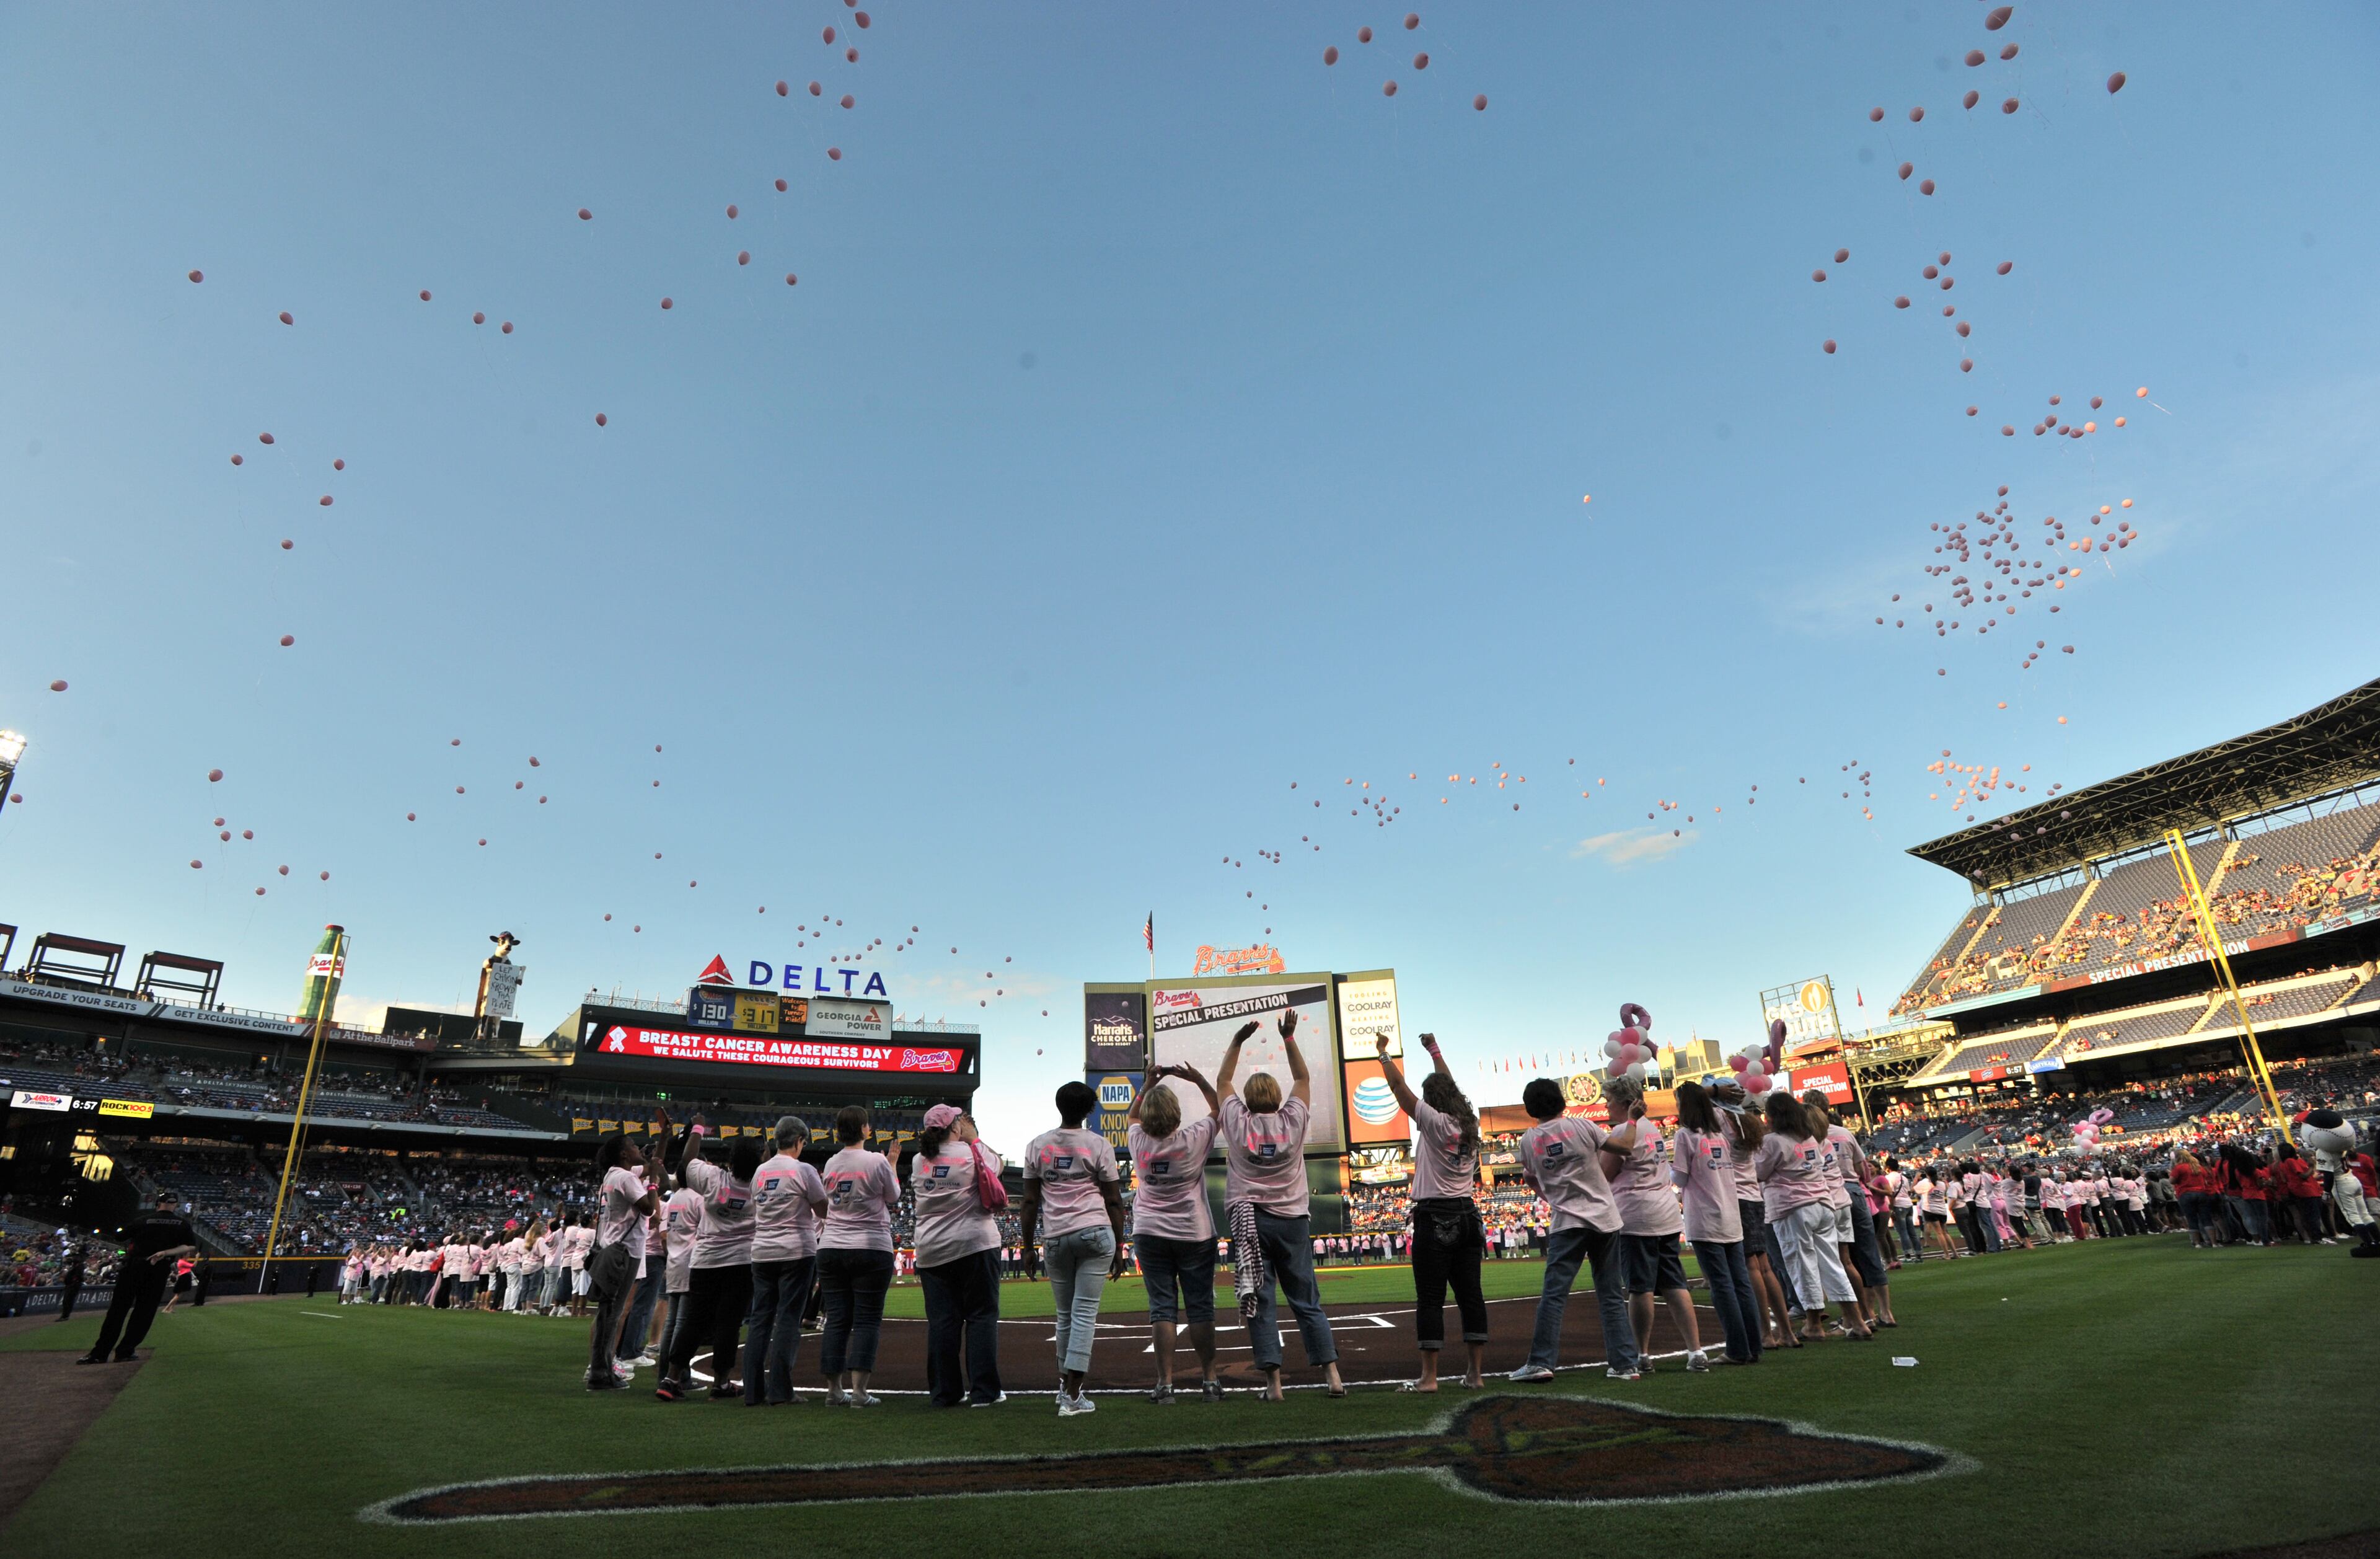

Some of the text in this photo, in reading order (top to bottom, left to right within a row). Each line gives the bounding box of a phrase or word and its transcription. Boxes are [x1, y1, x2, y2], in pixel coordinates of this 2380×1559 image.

[1193, 943, 1269, 977] Braves
[2089, 940, 2250, 984] SPECIAL PRESENTAION
[749, 960, 887, 996] DELTA
[13, 985, 137, 1011] UPGRADE YOUR SEATS
[498, 991, 510, 999] THA
[1153, 991, 1194, 1007] Braves
[491, 998, 513, 1010] PLATE
[1155, 993, 1289, 1030] SPECIAL PRESENTATION
[1348, 1000, 1393, 1012] COOLRAY
[1765, 1000, 1804, 1023] GAS
[175, 1010, 295, 1032] GET EXCLUSIVE CONTENT
[816, 1012, 862, 1022] GEORGIA
[847, 1022, 881, 1031] POWER
[1094, 1023, 1133, 1035] Harrah's
[1350, 1025, 1395, 1036] COOLRAY
[1784, 1011, 1835, 1041] OUTH
[342, 1031, 416, 1047] At the Ballpark
[640, 1031, 892, 1059] BREAST CANCER AWARENESS DAY
[653, 1046, 879, 1069] WE SALUTE THESE COURAGEOUS SURVIVORS
[901, 1049, 947, 1069] Braves
[2006, 1066, 2022, 1075] 6:57
[1802, 1075, 1833, 1087] SPECIAL
[1102, 1086, 1130, 1102] NAPA
[73, 1100, 98, 1110] 6:57
[242, 1261, 262, 1270] 335
[32, 1293, 57, 1306] DELTA
